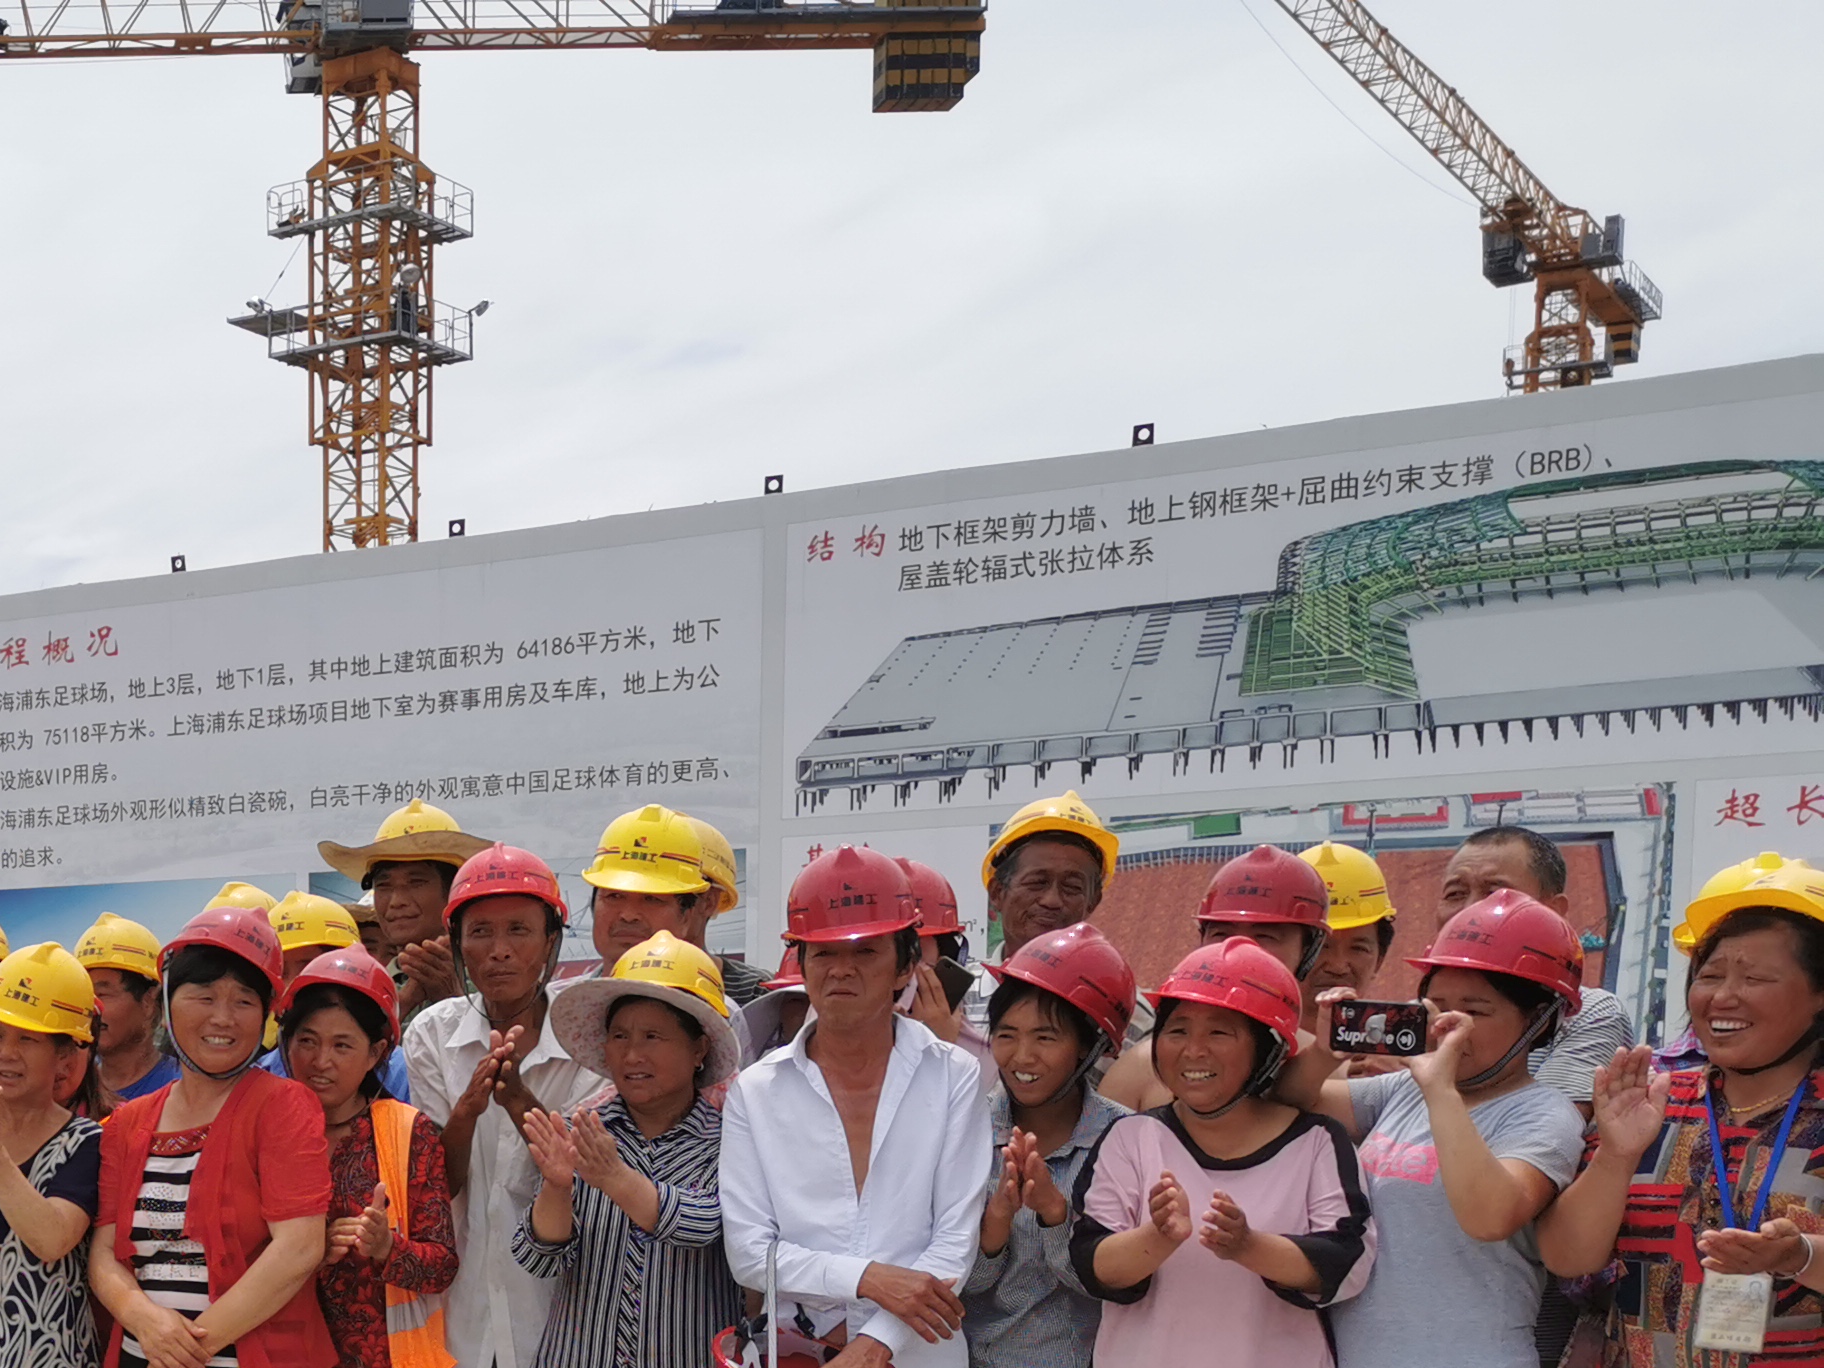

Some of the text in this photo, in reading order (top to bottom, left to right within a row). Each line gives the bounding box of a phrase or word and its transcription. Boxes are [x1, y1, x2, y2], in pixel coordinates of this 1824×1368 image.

[806, 523, 887, 564] 结构
[897, 536, 1155, 593] 屋盖轮辐式张拉体系
[1714, 784, 1824, 828] 超长
[1336, 1026, 1395, 1046] Supre
